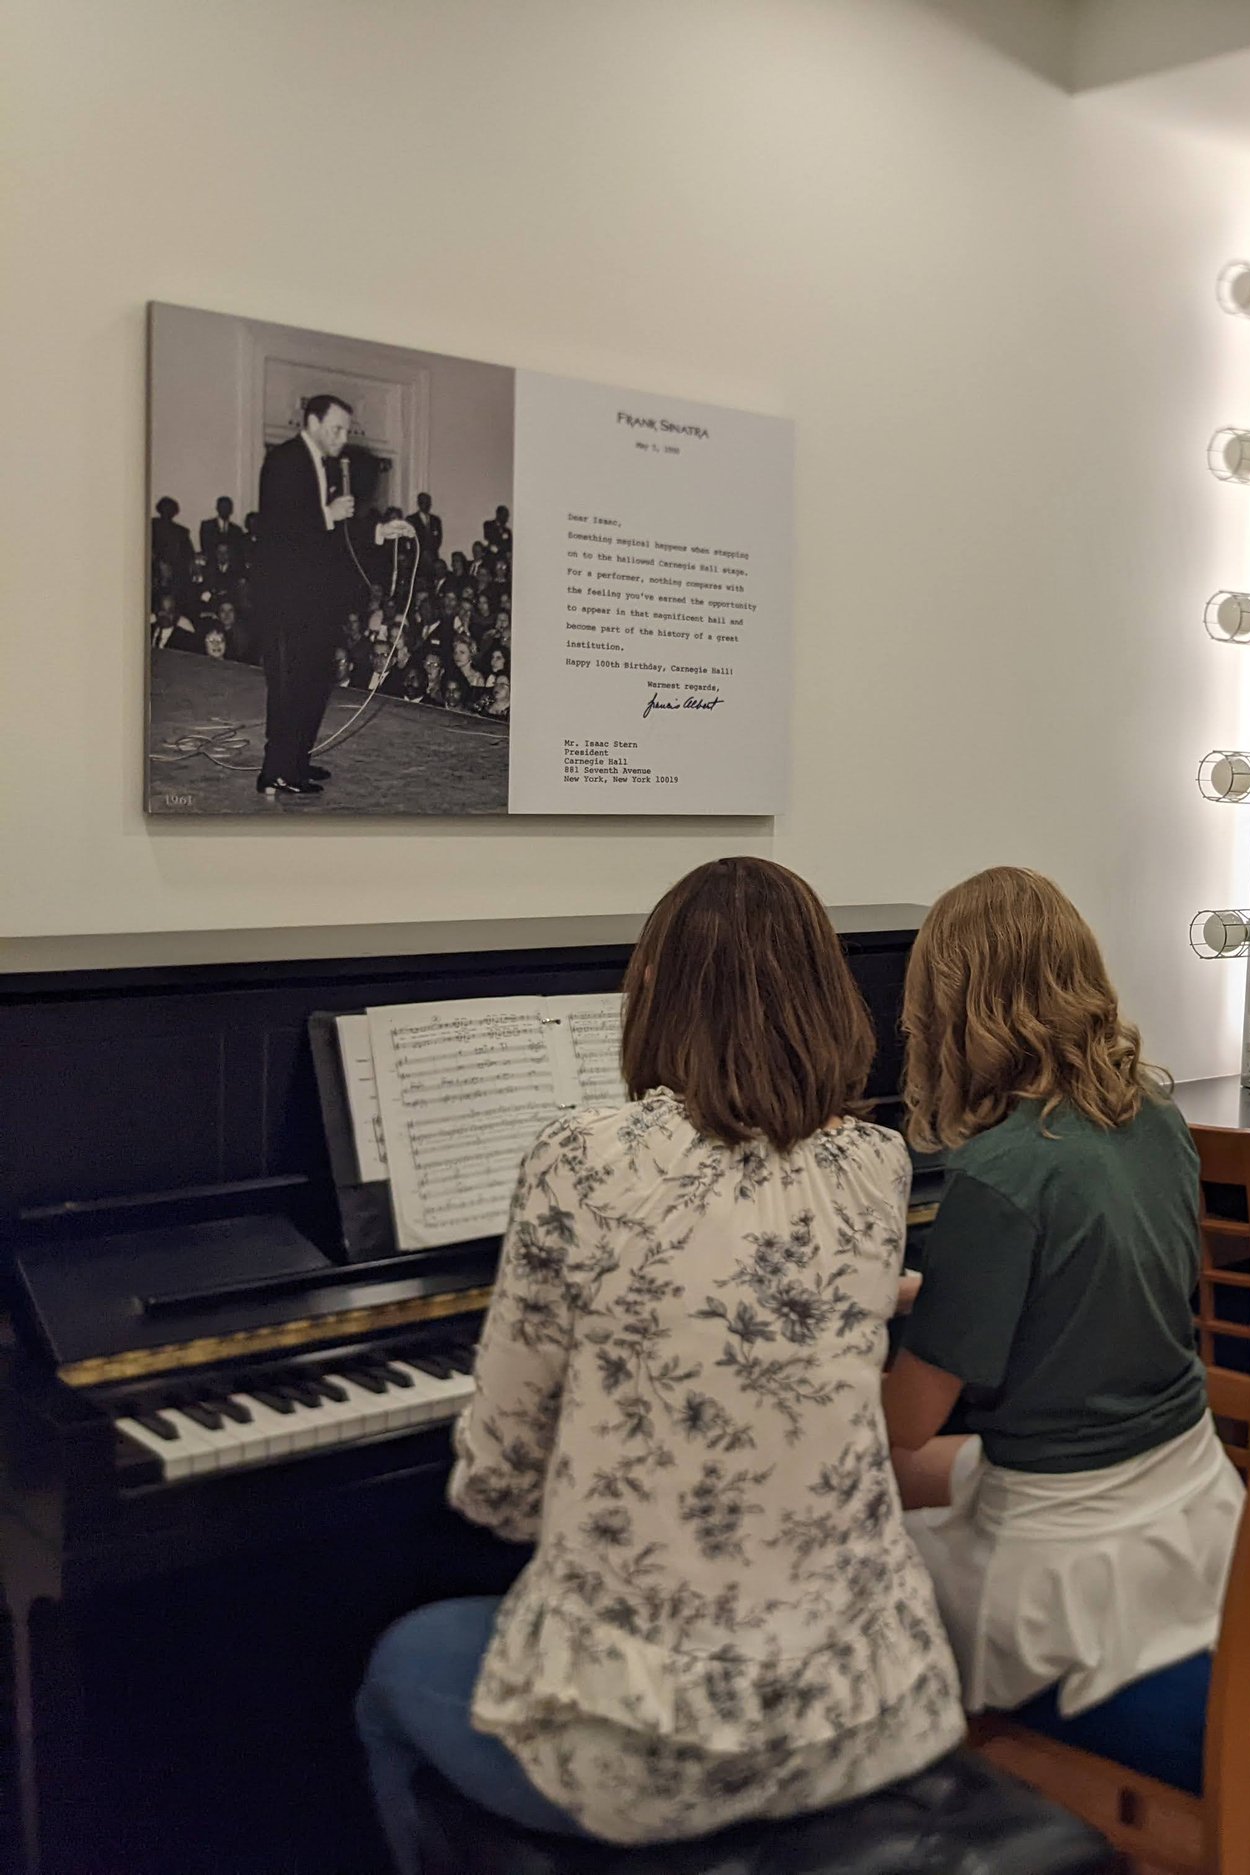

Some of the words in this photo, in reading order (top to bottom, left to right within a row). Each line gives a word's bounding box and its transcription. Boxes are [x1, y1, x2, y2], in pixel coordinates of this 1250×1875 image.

[617, 411, 658, 432] FRANK
[660, 419, 709, 440] SINATRA
[568, 513, 587, 523] Dear
[593, 517, 621, 528] Isaac,
[568, 532, 612, 545] Something
[616, 538, 649, 548] magical
[655, 541, 687, 552] happens
[691, 546, 710, 554] when
[714, 549, 749, 560] stepping
[567, 551, 578, 559] on
[598, 553, 612, 561] the
[617, 555, 655, 566] hallowed
[659, 560, 696, 571] Carnegie
[700, 564, 718, 573] Hall
[722, 567, 748, 577] stage.
[567, 568, 582, 576] For
[597, 572, 644, 583] performer,
[649, 577, 682, 588] nothing
[686, 581, 722, 590] compares
[726, 585, 744, 593] with
[567, 586, 582, 594] the
[587, 588, 621, 599] feeling
[625, 592, 654, 601] you've
[658, 595, 686, 604] earned
[708, 600, 757, 612] opportunity
[567, 604, 577, 612] to
[581, 606, 611, 615] appear
[630, 610, 649, 618] that
[653, 612, 703, 623] magnificent
[708, 616, 725, 625] hall
[730, 618, 743, 626] and
[566, 622, 596, 631] become
[601, 626, 620, 634] part
[640, 628, 653, 636] the
[658, 629, 690, 640] history
[716, 635, 739, 643] great
[566, 640, 624, 651] institution.
[566, 658, 590, 668] Happy
[596, 660, 620, 669] 100th
[624, 662, 666, 673] Birthday,
[671, 665, 707, 675] Carnegie
[711, 667, 733, 675] Hall!
[647, 681, 680, 690] Warmest
[684, 684, 720, 693] regards,
[585, 740, 609, 748] Isaac
[613, 740, 638, 749] Stern
[564, 749, 609, 757] President
[564, 758, 604, 766] Carnegie
[608, 758, 628, 766] Hall
[564, 766, 579, 774] 881
[622, 767, 651, 775] Avenue
[583, 775, 607, 784] York,
[656, 776, 679, 784] 10019
